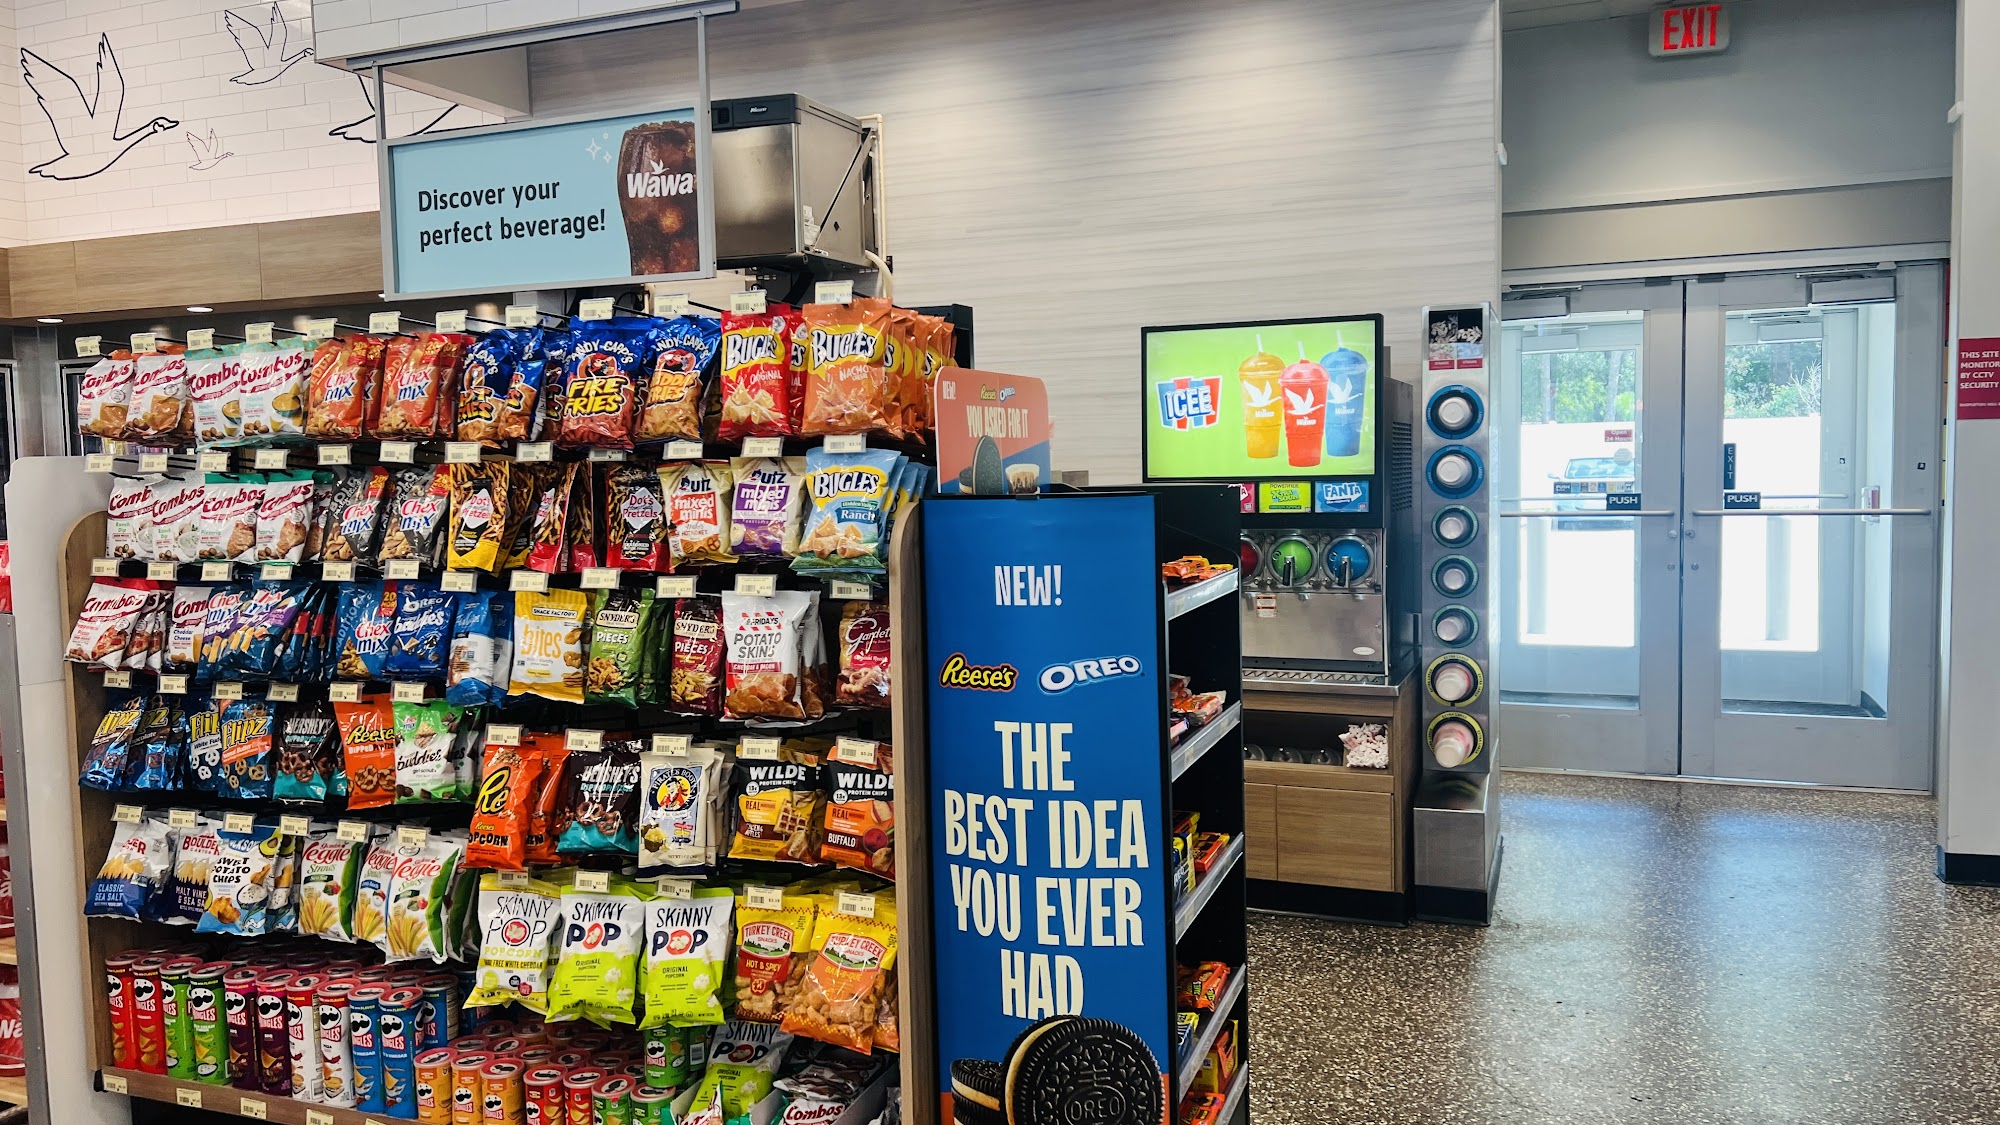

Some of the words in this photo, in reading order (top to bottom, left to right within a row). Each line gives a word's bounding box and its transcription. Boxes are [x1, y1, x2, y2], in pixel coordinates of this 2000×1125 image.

[1663, 4, 1721, 50] EXIT
[626, 173, 694, 198] Wawa
[418, 187, 505, 212] Discover
[512, 181, 560, 208] your
[419, 219, 491, 252] perfect
[500, 209, 606, 240] beverage!
[725, 332, 777, 371] BUGLES
[812, 329, 876, 369] BUGLES
[327, 368, 357, 388] Chex
[399, 367, 432, 387] Chex
[750, 370, 782, 384] ORIGINAL
[839, 365, 869, 381] NACHO
[571, 378, 622, 397] FIRE
[1000, 387, 1016, 401] OREO
[565, 396, 622, 417] FRIES
[1165, 385, 1211, 418] ICEE
[967, 405, 982, 437] YOU
[985, 406, 1006, 438] ASKED
[1008, 408, 1021, 438] FOR
[1022, 409, 1029, 438] IT
[740, 486, 784, 500] mixed
[814, 470, 880, 499] BUGLES
[1324, 483, 1360, 498] FANTA
[401, 499, 440, 516] Chex
[629, 495, 653, 505] Dot's
[675, 495, 714, 509] mixed
[1609, 496, 1638, 505] PUSH
[1727, 495, 1757, 503] PUSH
[343, 501, 377, 520] Chex
[622, 509, 657, 519] Pretzels
[680, 506, 713, 520] minis
[840, 509, 876, 524] Ranch
[994, 565, 1062, 606] NEW!
[209, 591, 244, 609] Chex
[404, 597, 443, 613] OREO
[533, 608, 548, 616] SNACK
[357, 620, 392, 638] Chex
[676, 620, 717, 636] SNYDER'S
[521, 623, 562, 659] bites
[596, 632, 629, 644] PIECES
[733, 632, 782, 646] POTATO
[674, 641, 708, 655] PIECES
[737, 646, 775, 660] SKINS
[942, 656, 1013, 688] Reese's
[1041, 657, 1140, 691] OREO
[222, 718, 267, 750] Flipz
[994, 720, 1075, 791] THE
[749, 765, 806, 782] WILDE
[848, 789, 870, 797] PROTEIN
[745, 799, 761, 810] REAL
[832, 808, 849, 819] REAL
[944, 789, 1034, 866] BEST
[1048, 799, 1149, 869] IDEA
[827, 832, 856, 848] BUFFALO
[302, 841, 351, 864] Veggie
[392, 857, 441, 881] Veggie
[98, 883, 124, 893] CLASSIC
[213, 875, 241, 884] CHIPS
[95, 893, 107, 901] SEA
[107, 892, 124, 902] SALT
[175, 886, 190, 896] MALT
[183, 895, 197, 906] SEA
[497, 896, 553, 918] SKINNY
[950, 864, 1021, 942] YOU
[1036, 877, 1144, 947] EVER
[572, 902, 628, 922] SKINNY
[656, 905, 713, 928] SKINNY
[486, 916, 546, 948] POP
[565, 922, 621, 949] POP
[745, 926, 771, 938] TURKEY
[772, 926, 791, 943] CREEK
[757, 936, 778, 944] SNACKS
[652, 929, 708, 956] POP
[858, 939, 883, 957] CREEK
[484, 946, 542, 958] POPCORN
[504, 961, 520, 969] WHITE
[520, 962, 542, 970] CHEDDAR
[575, 958, 601, 967] ORIGINAL
[662, 966, 688, 974] ORIGINAL
[745, 959, 759, 967] HOT
[765, 963, 782, 973] SPICY
[1001, 949, 1084, 1020] HAD
[726, 1021, 779, 1044] SKINNY
[712, 1043, 770, 1064] POP
[717, 1068, 741, 1076] ORIGINAL
[785, 1103, 843, 1124] Combos
[1070, 1096, 1121, 1121] OREO
